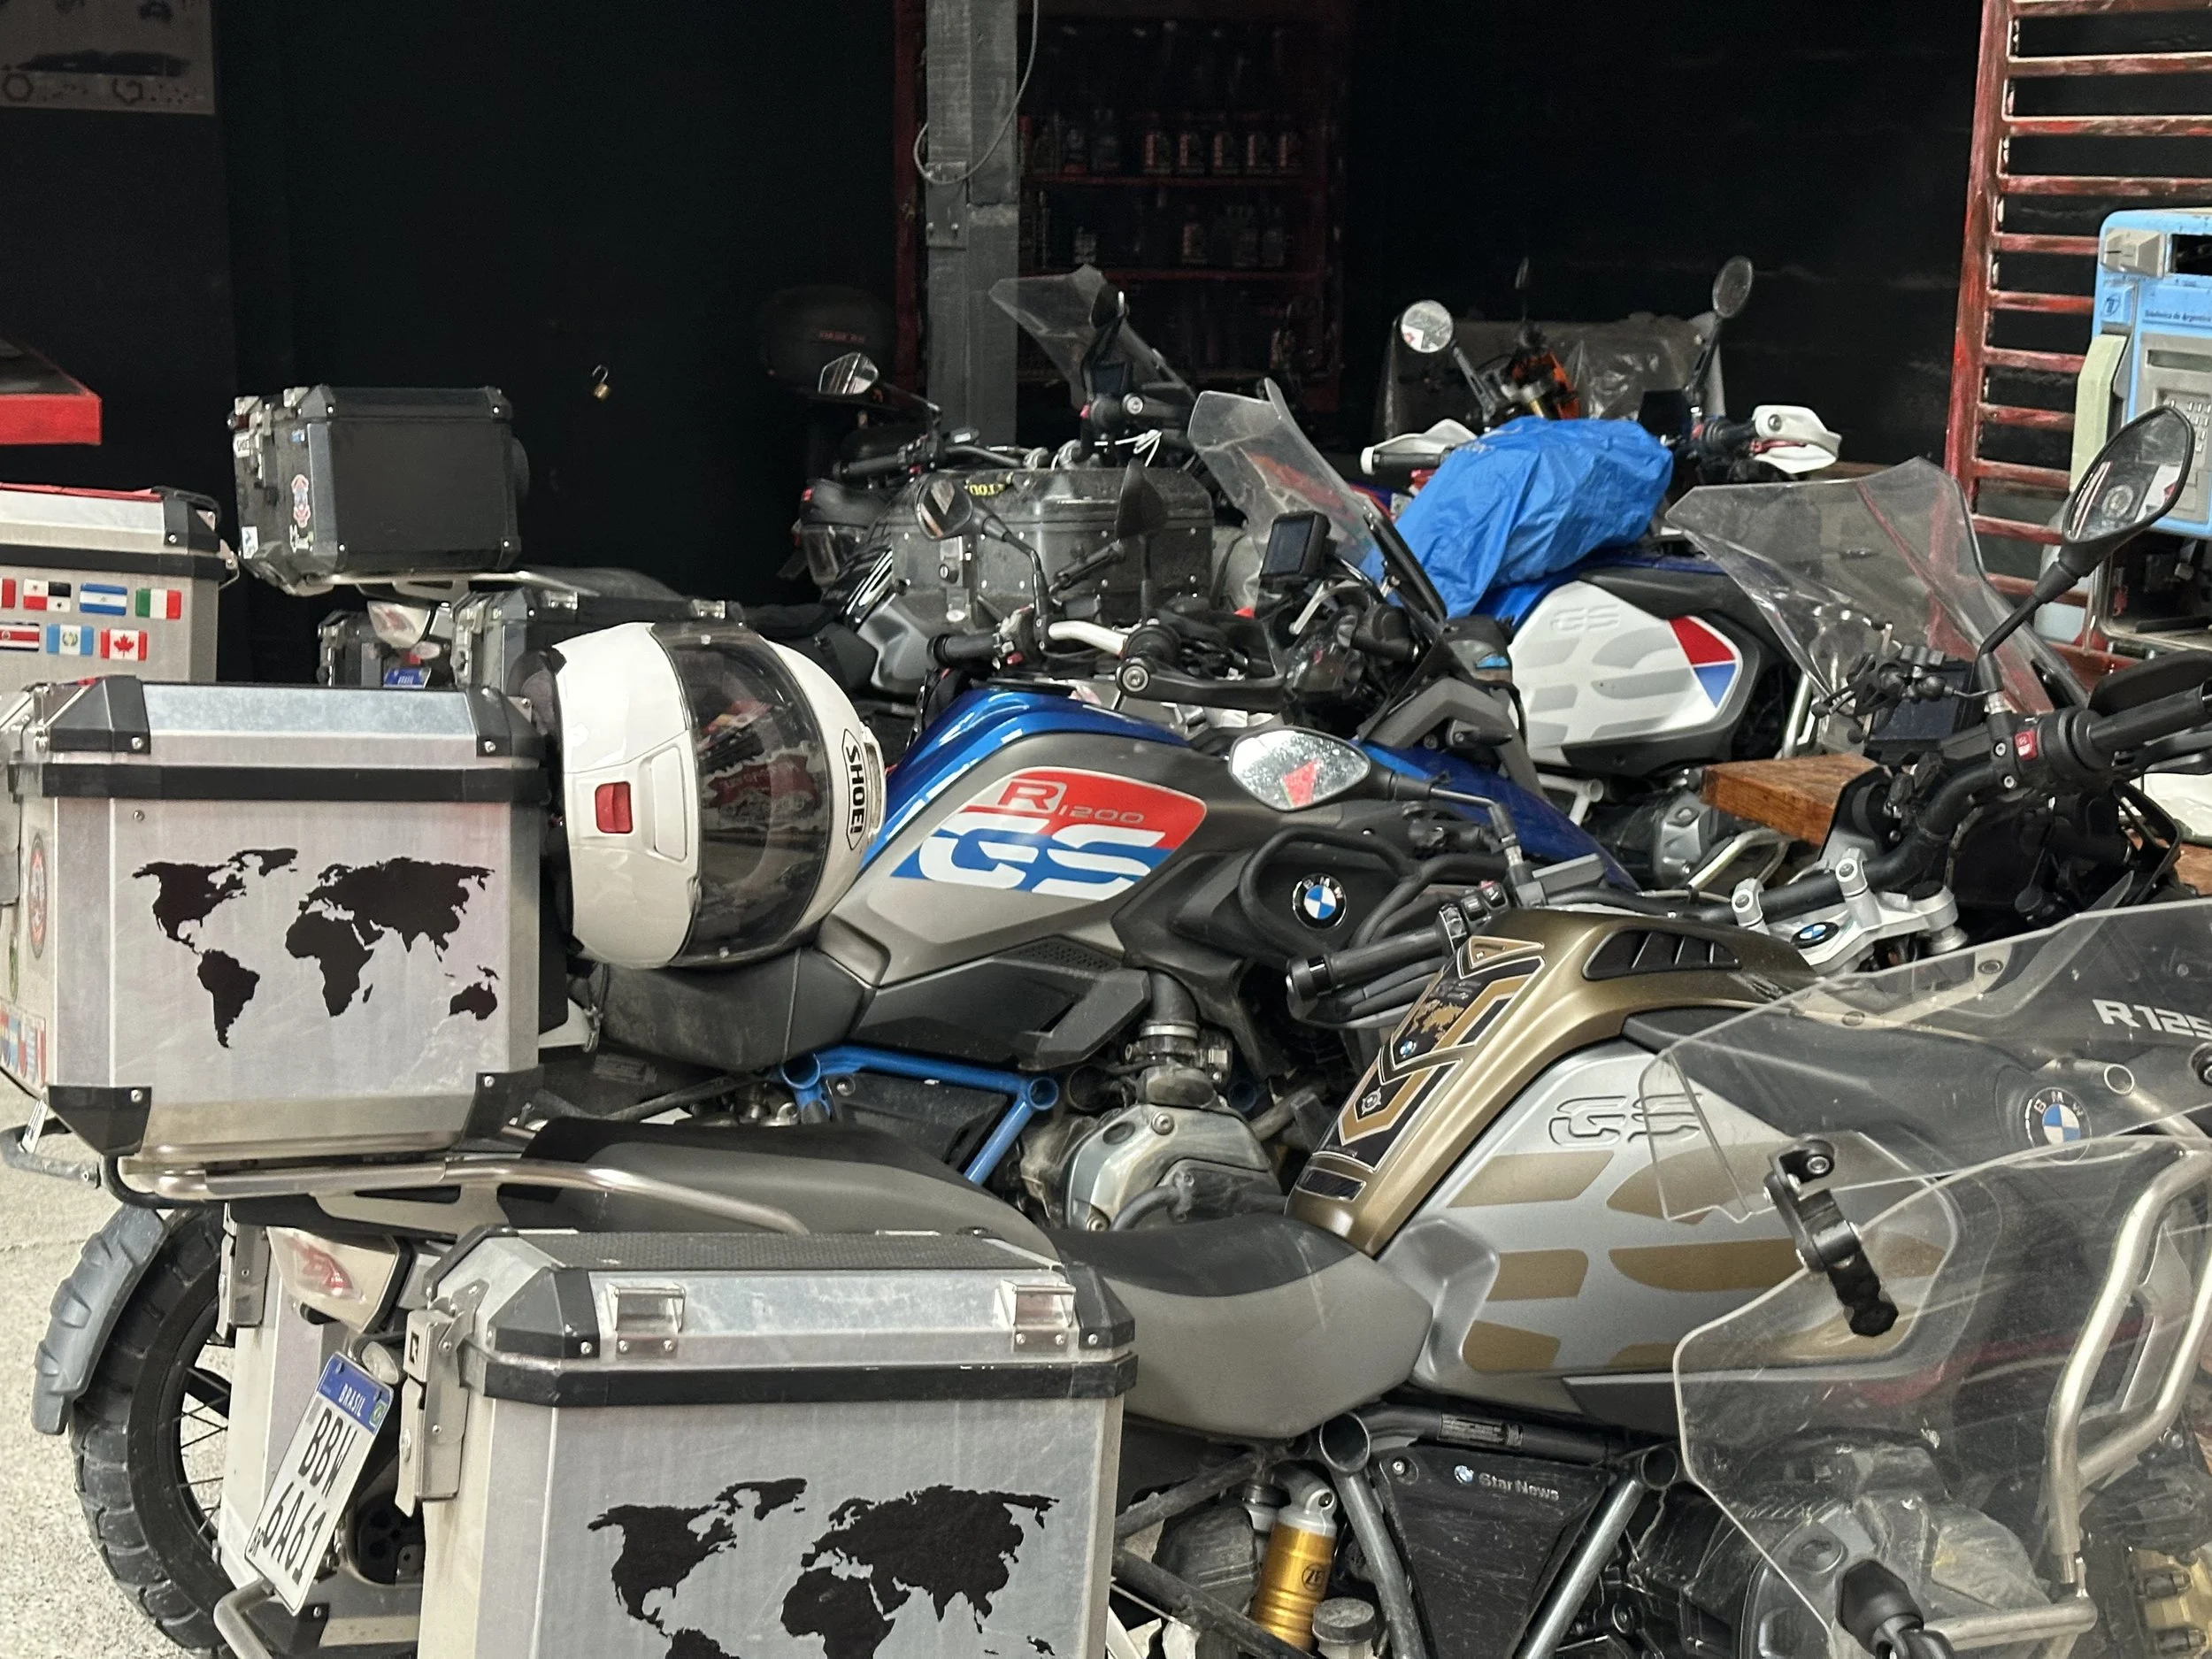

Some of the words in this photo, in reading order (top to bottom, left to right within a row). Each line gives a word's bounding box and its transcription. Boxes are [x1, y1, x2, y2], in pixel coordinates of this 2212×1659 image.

[1549, 603, 1620, 632] GS
[846, 744, 865, 834] SHOEI
[997, 780, 1066, 812] R
[1057, 806, 1144, 824] 1200
[919, 811, 1165, 901] GS
[1548, 1093, 1702, 1148] GS
[2033, 1090, 2084, 1117] BMW
[338, 1384, 367, 1417] BRASIL
[297, 1407, 358, 1499] BBW
[262, 1482, 326, 1586] 6A61
